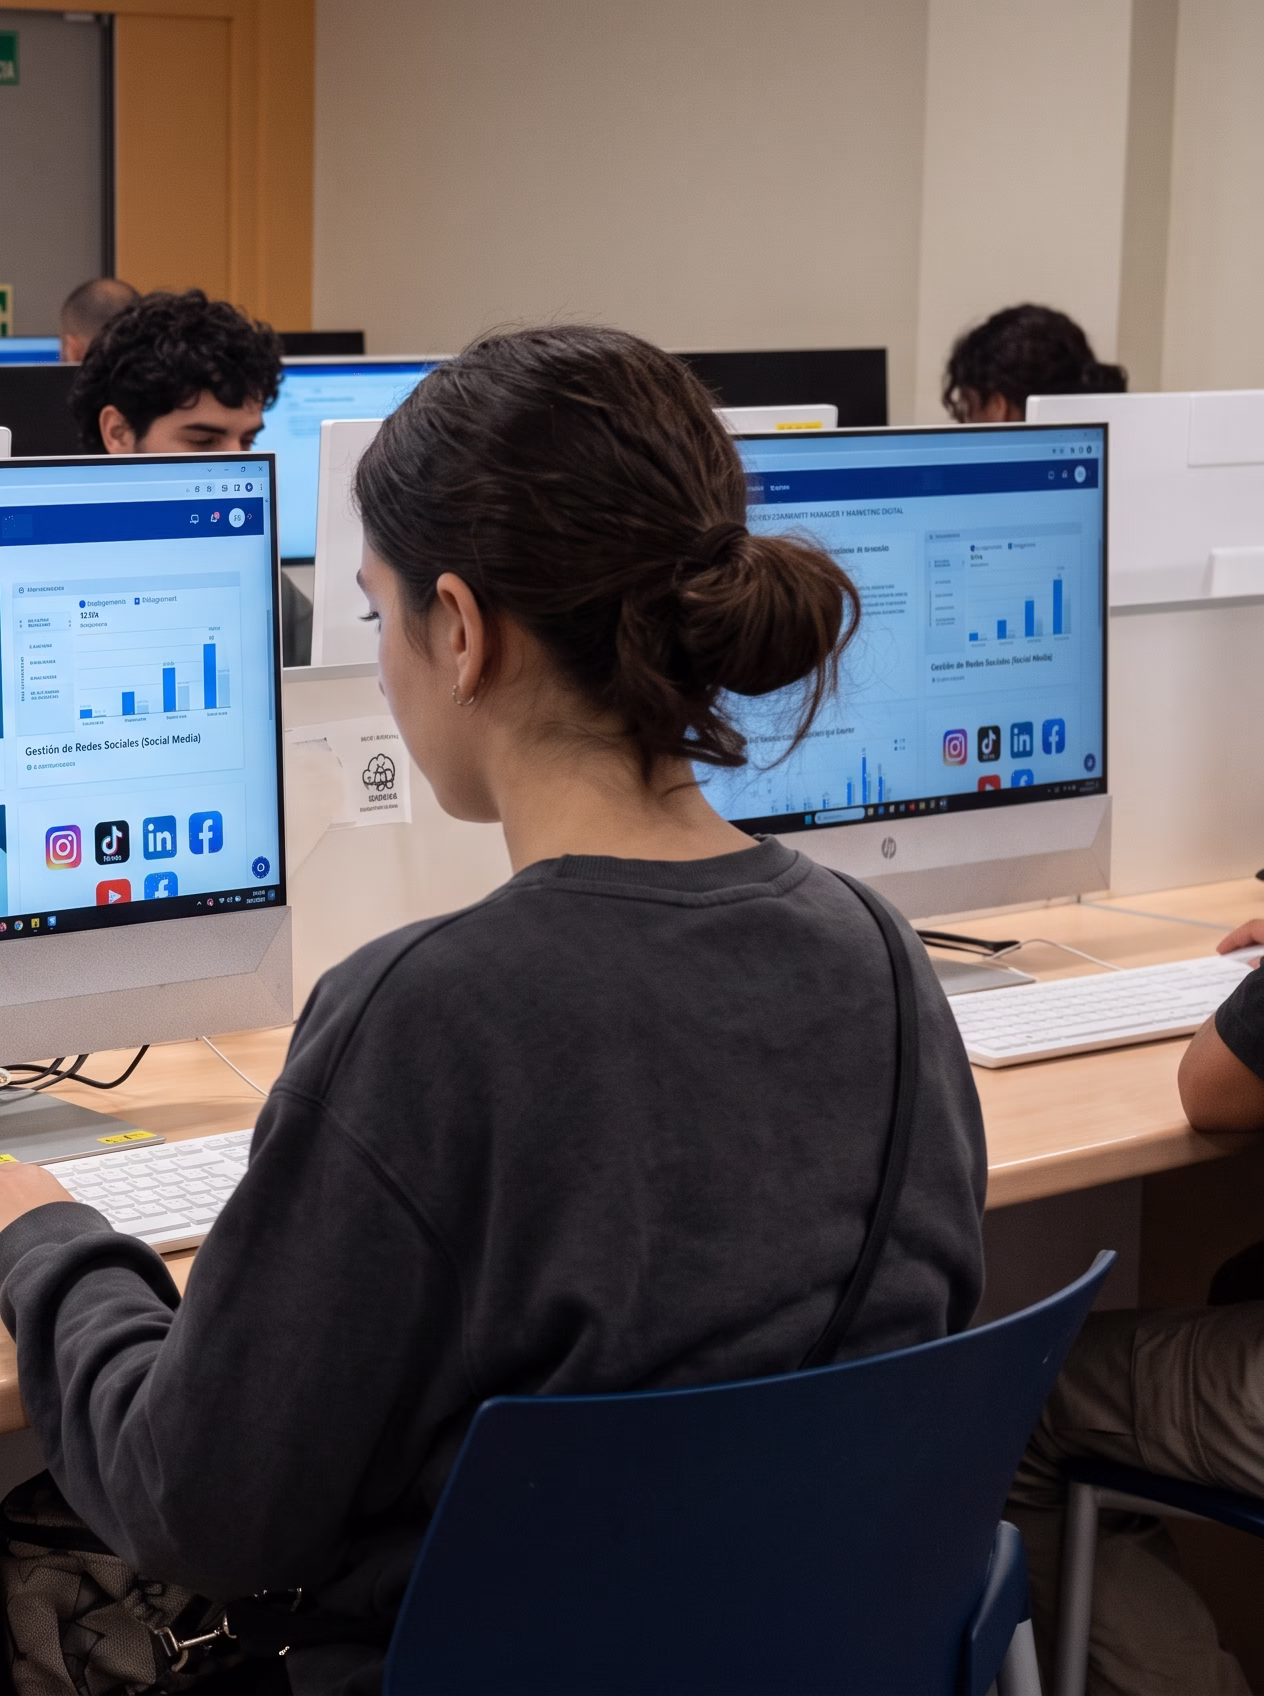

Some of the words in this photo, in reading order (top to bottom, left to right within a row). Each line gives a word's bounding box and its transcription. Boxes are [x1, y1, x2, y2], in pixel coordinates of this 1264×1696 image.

[25, 744, 60, 757] Gestión
[62, 743, 73, 753] de
[75, 741, 102, 753] Redes
[104, 738, 139, 750] Sociales
[141, 735, 170, 749] (Social
[172, 732, 201, 745] Media)
